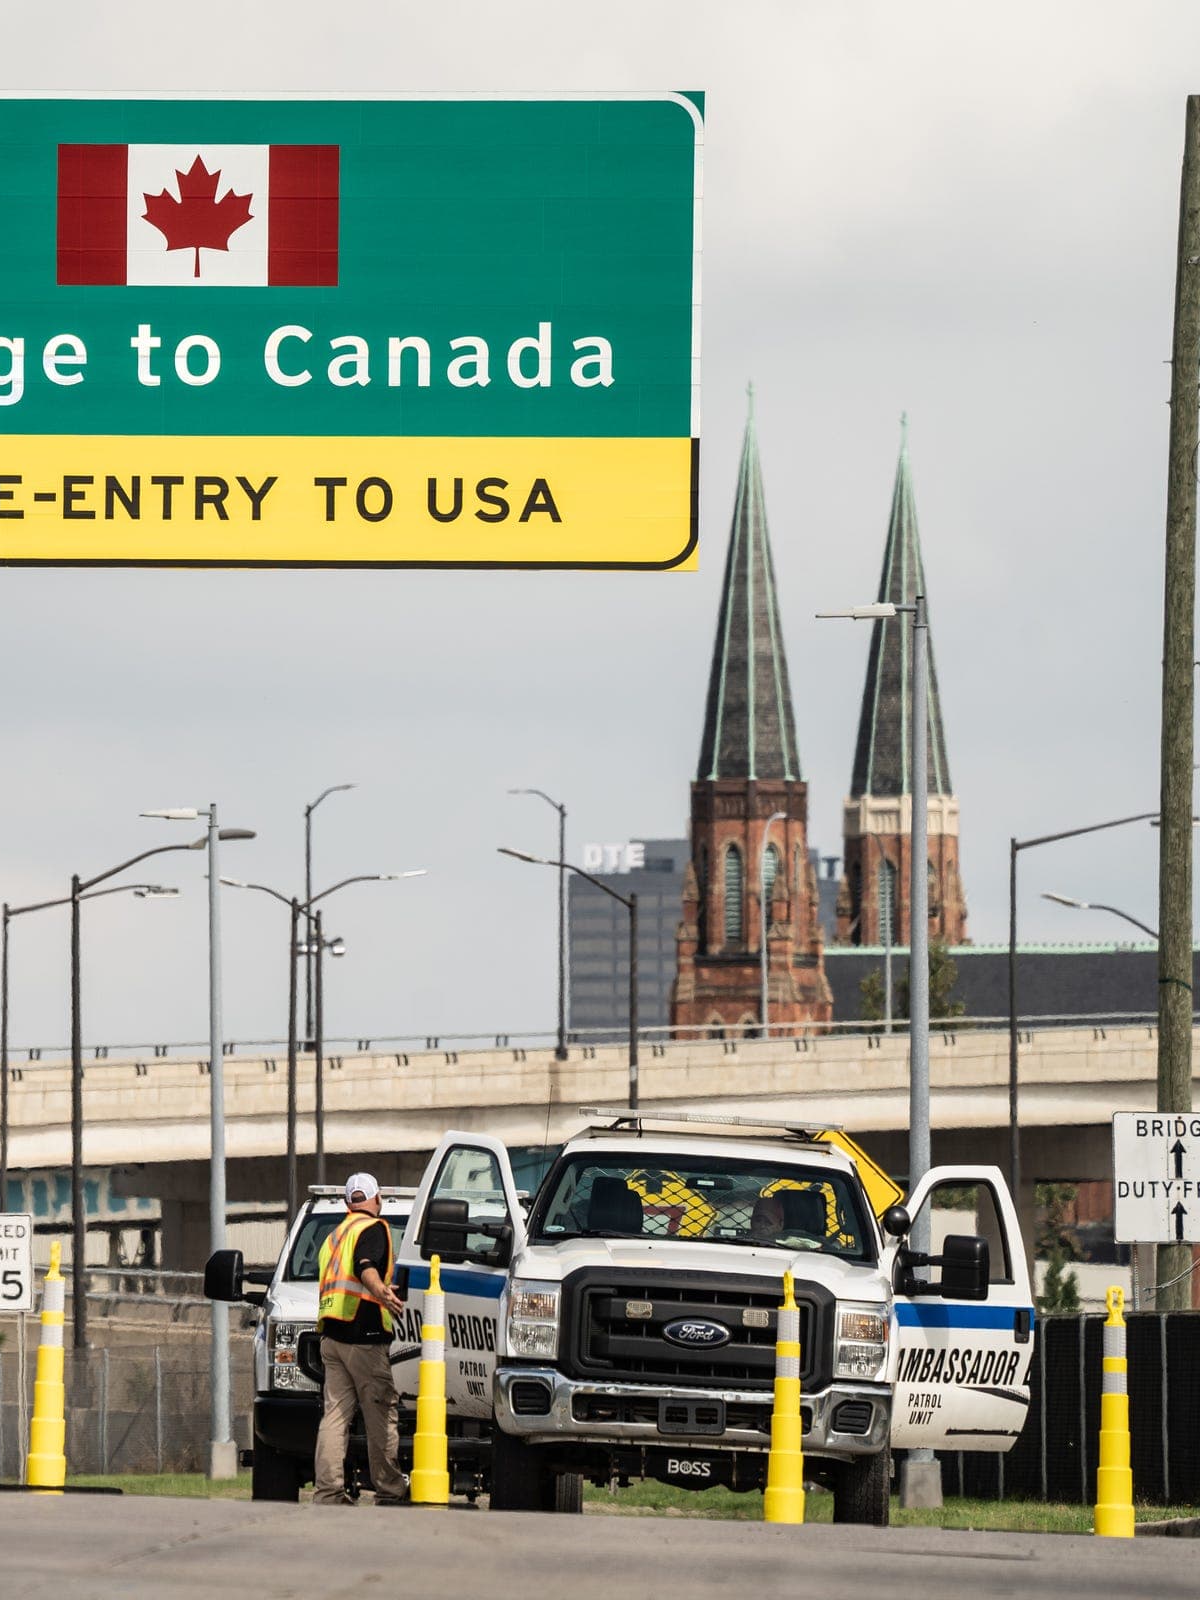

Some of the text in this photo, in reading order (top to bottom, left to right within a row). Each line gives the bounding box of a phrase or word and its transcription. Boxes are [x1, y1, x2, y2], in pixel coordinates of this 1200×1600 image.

[130, 324, 221, 387] to
[265, 322, 615, 388] Canada
[314, 476, 393, 523] TO
[427, 477, 563, 523] USA
[584, 843, 645, 871] DTE
[1118, 1181, 1174, 1198] DUTY
[448, 1312, 497, 1352] BRIDG
[678, 1323, 714, 1341] Ford
[459, 1360, 488, 1378] PATROL
[466, 1380, 486, 1397] UNIT
[907, 1393, 942, 1409] PATROL
[908, 1410, 934, 1425] UNIT
[667, 1459, 711, 1477] BOSS
